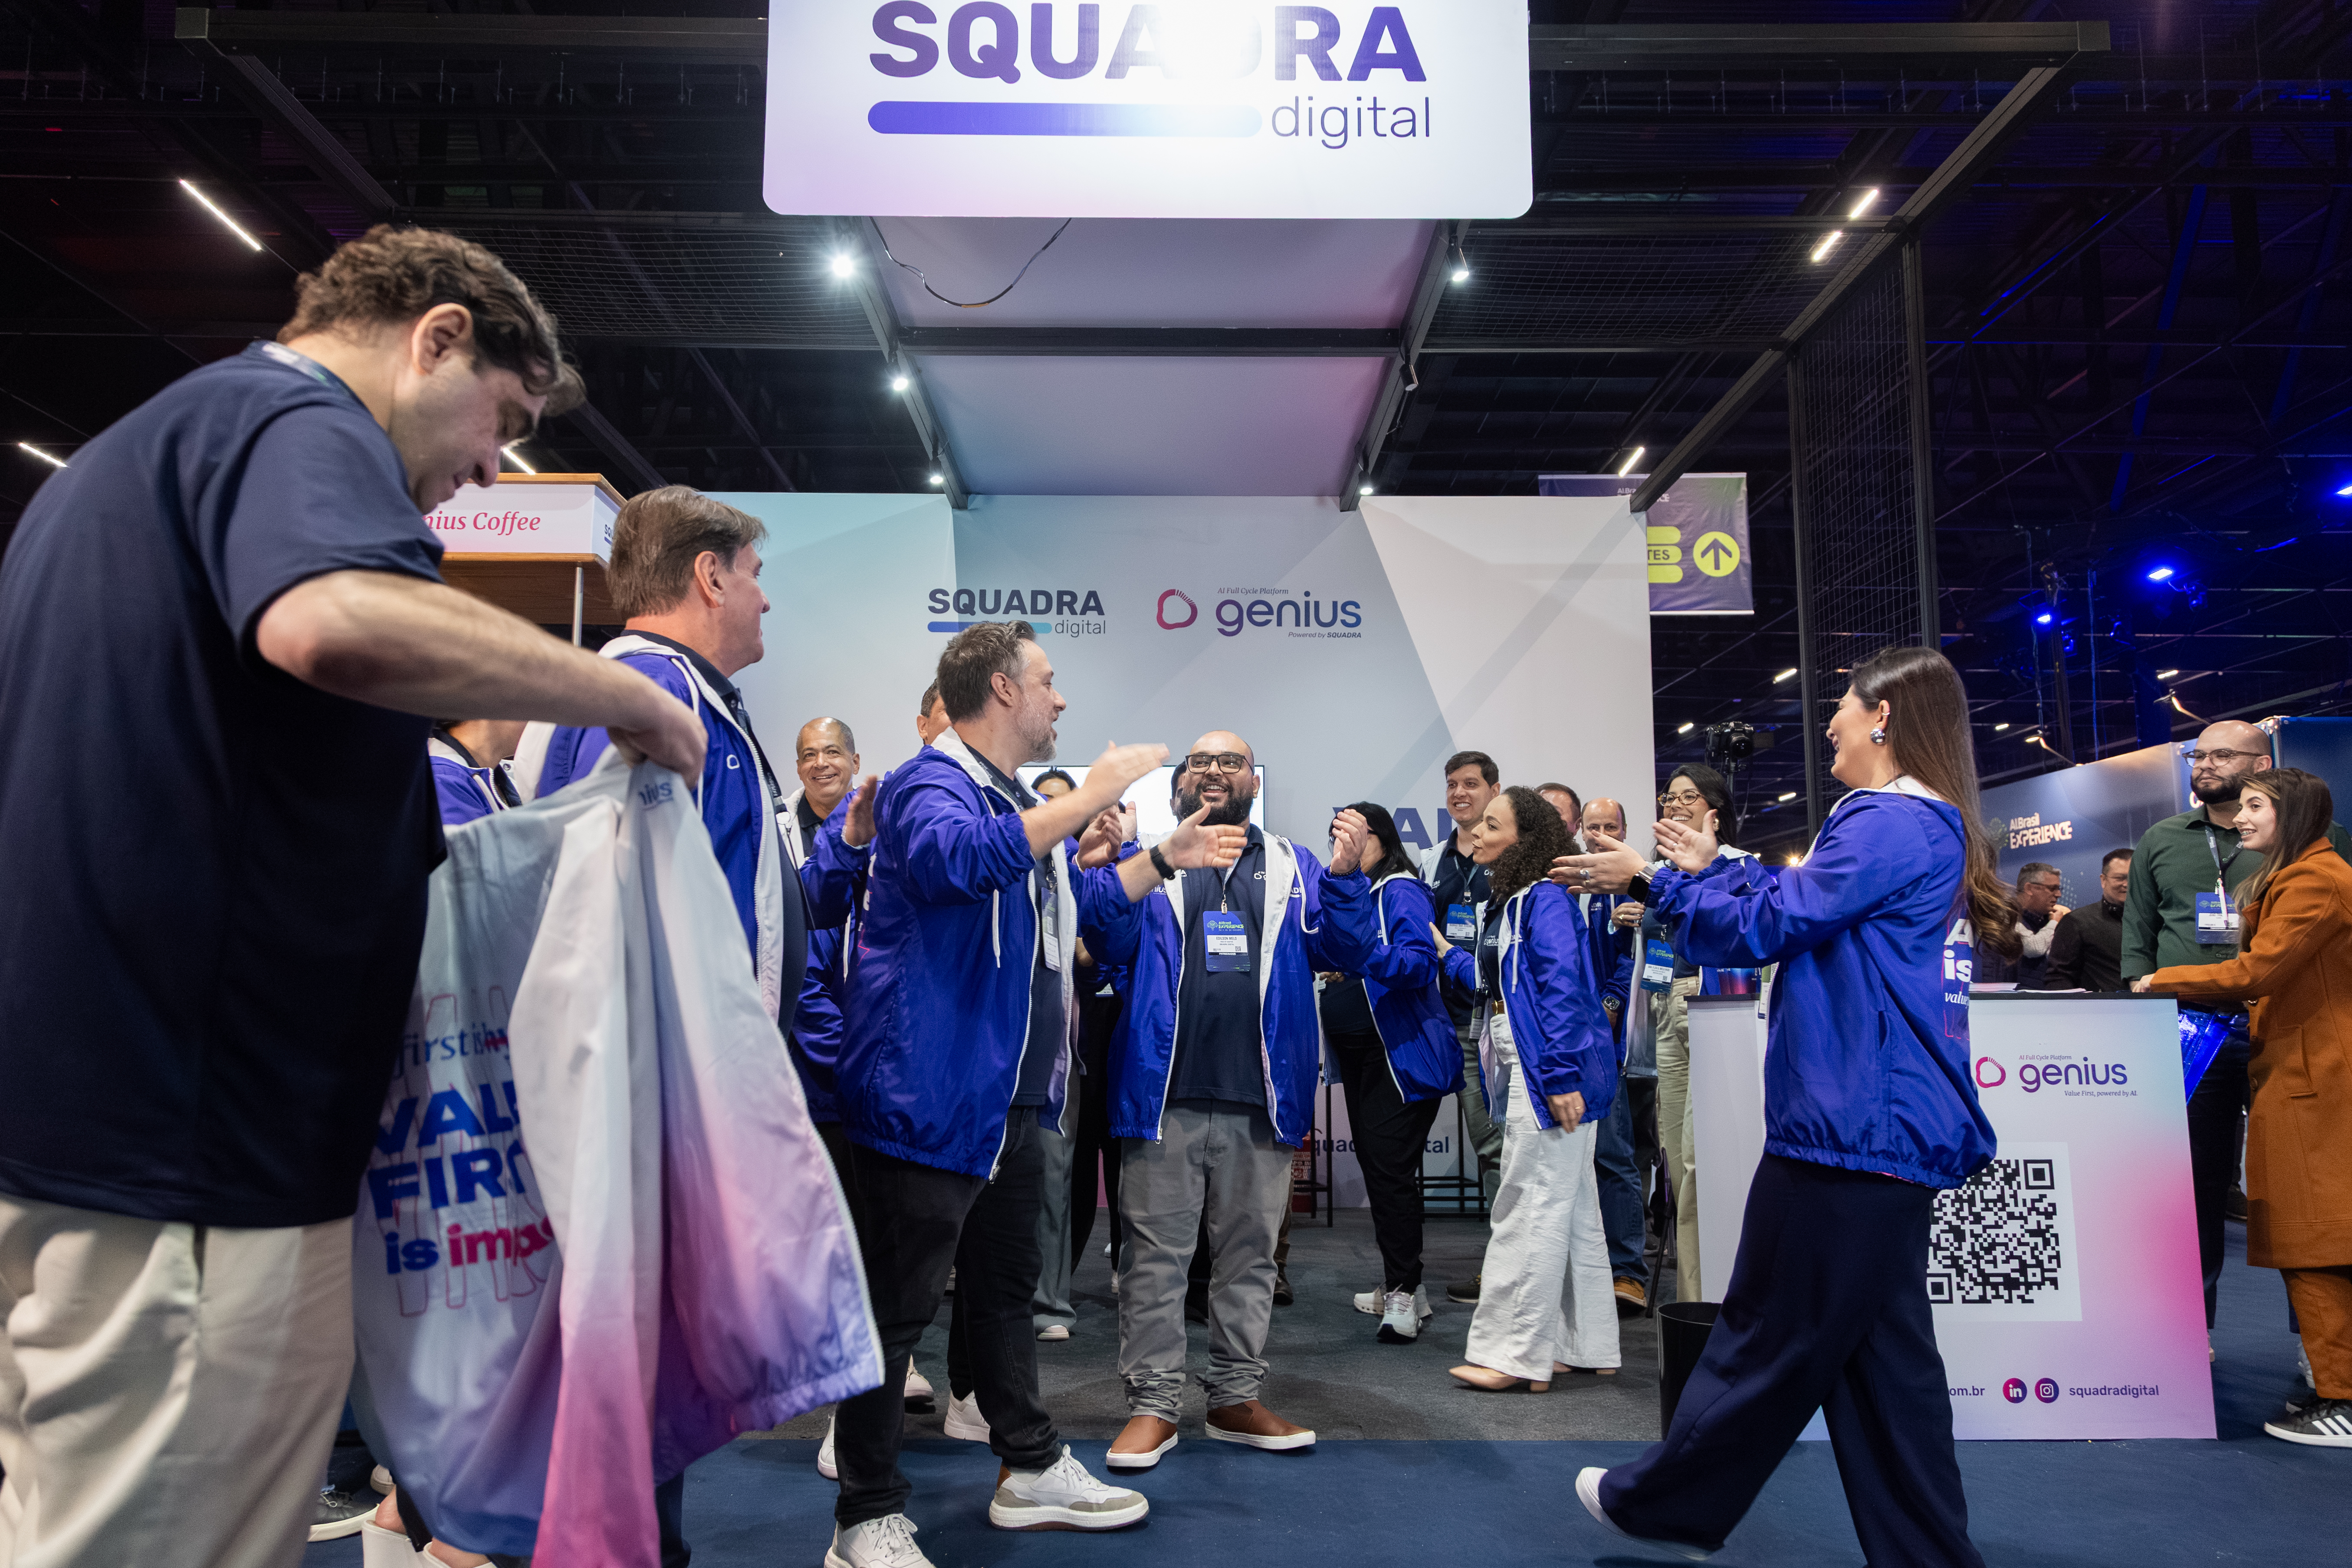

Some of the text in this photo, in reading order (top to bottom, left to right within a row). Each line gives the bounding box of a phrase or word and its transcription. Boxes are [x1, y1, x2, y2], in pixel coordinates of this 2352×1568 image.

[1272, 96, 1431, 149] digital
[473, 511, 541, 535] Coffee
[928, 588, 1105, 616] SQUADRA
[1216, 591, 1362, 637] genius
[1055, 620, 1105, 638] digital
[1944, 950, 1972, 982] is
[2019, 1056, 2127, 1093] genius
[385, 1232, 438, 1274] is
[2069, 1385, 2159, 1398] squadradigital
